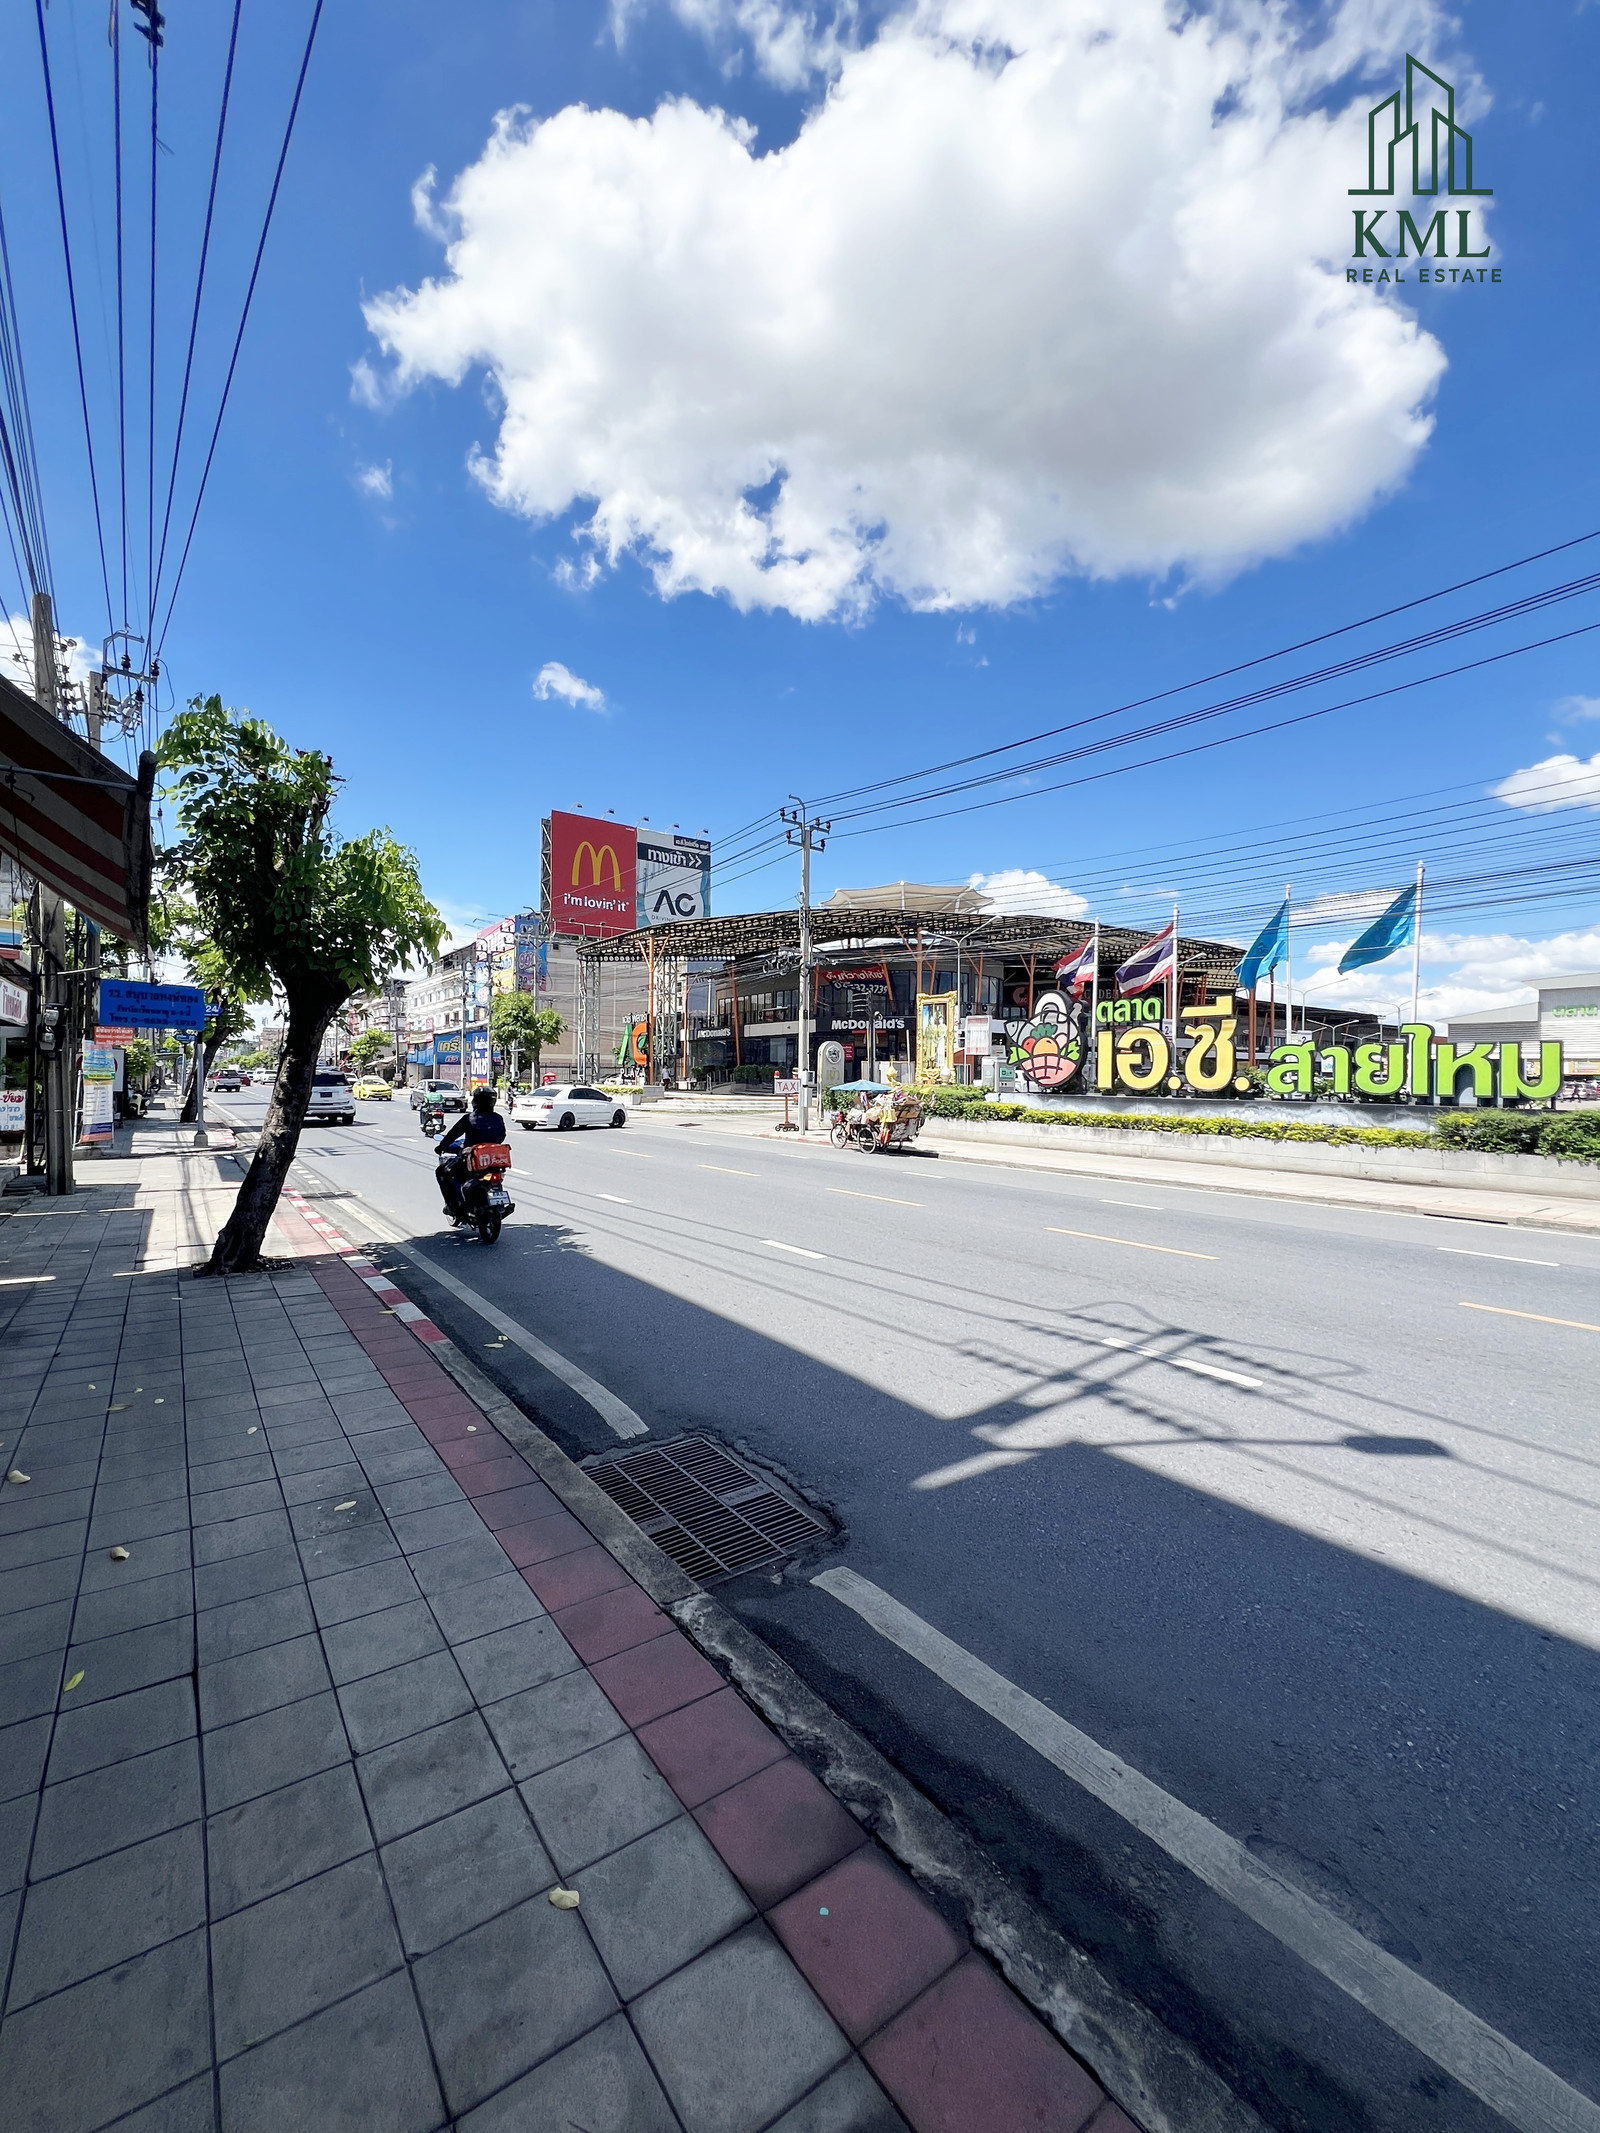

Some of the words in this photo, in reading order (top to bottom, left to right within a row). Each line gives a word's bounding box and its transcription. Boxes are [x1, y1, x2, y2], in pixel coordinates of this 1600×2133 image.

[648, 849, 687, 866] ทางเข้า
[563, 893, 583, 906] i'm
[584, 896, 616, 910] lovin'
[617, 900, 627, 912] it
[652, 889, 697, 917] AC
[206, 1004, 219, 1013] 24
[1096, 997, 1162, 1023] ตลาด
[1097, 995, 1250, 1092] เอ.ซี.
[1267, 1022, 1563, 1100] สายไหม
